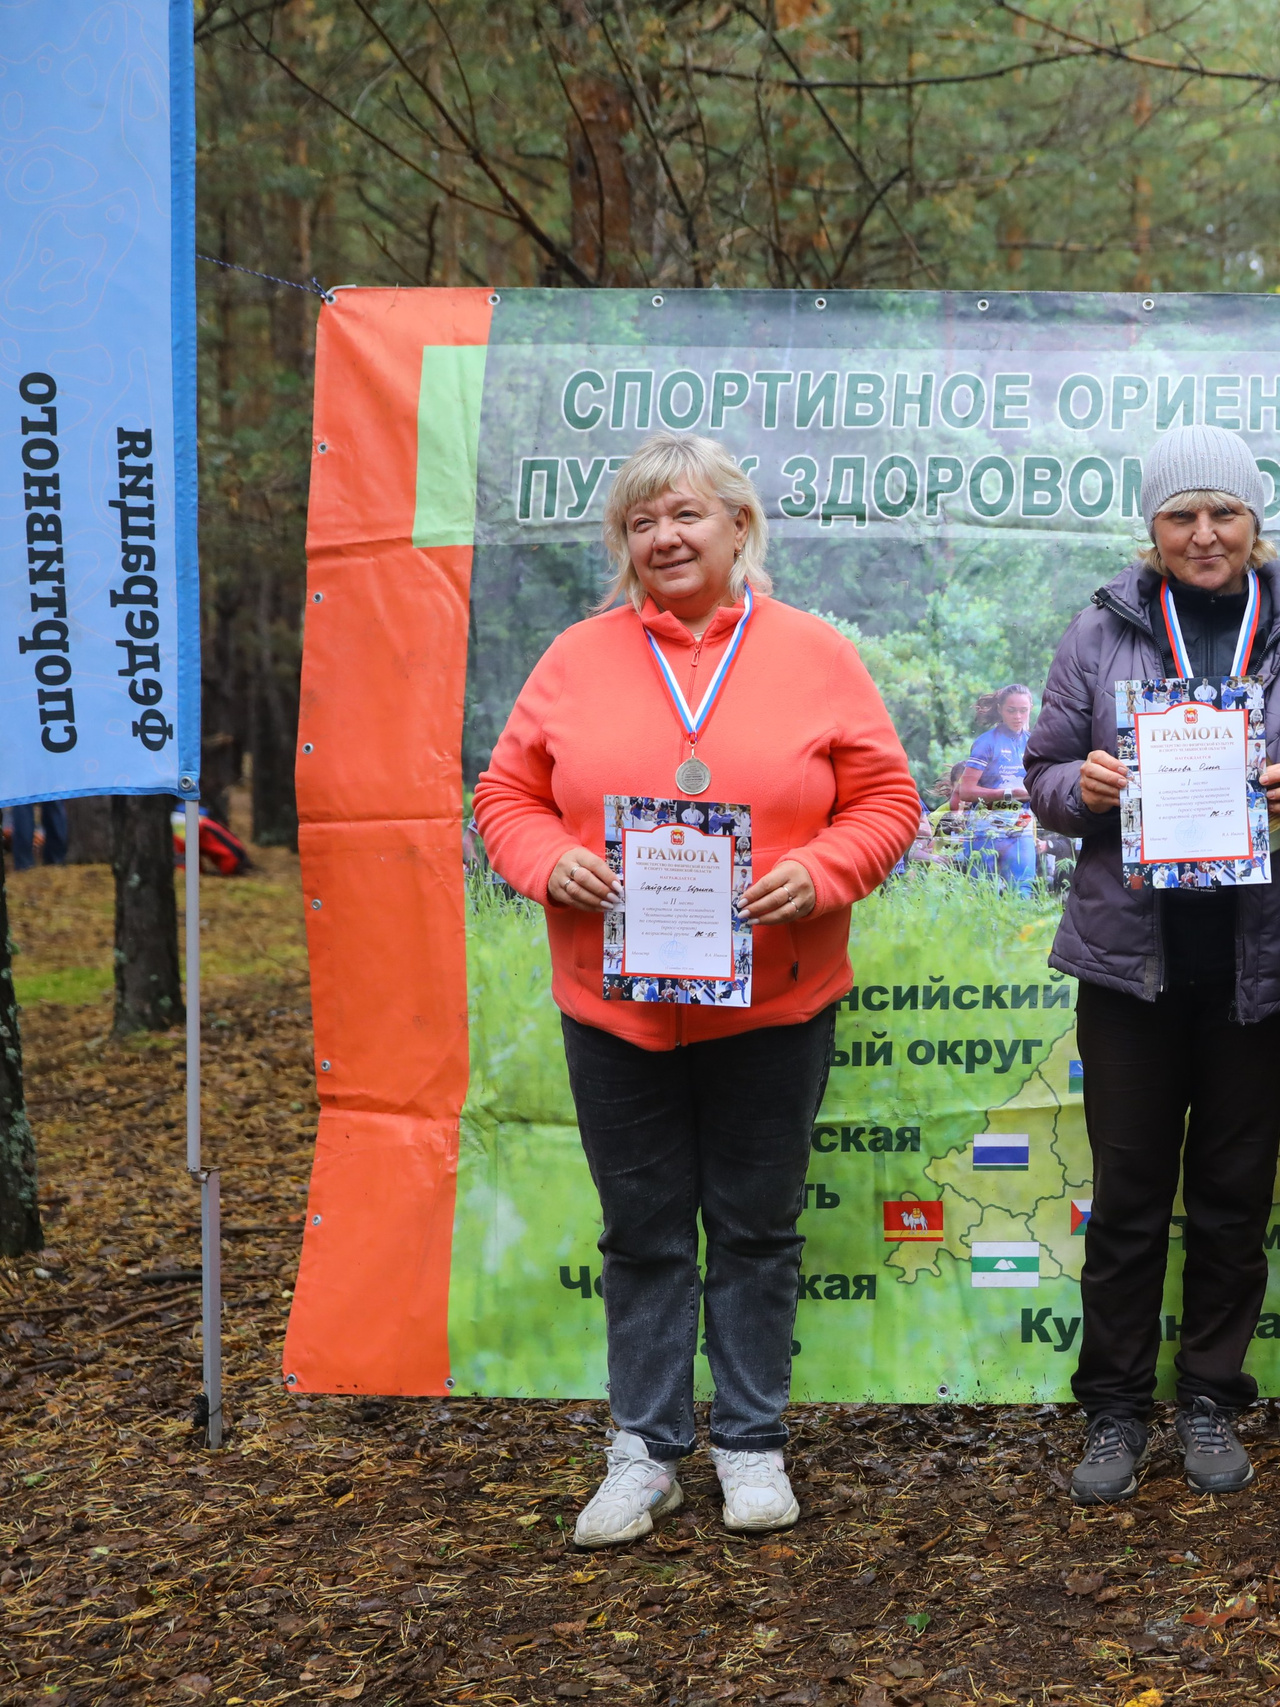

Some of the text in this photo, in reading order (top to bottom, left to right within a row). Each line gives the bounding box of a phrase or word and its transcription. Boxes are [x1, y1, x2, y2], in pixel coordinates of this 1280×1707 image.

[562, 369, 1031, 431] СПОРТИВНОЕ
[780, 455, 1144, 529] ЗДОРОВО
[1151, 726, 1233, 741] ГРАМОТА
[636, 846, 719, 863] ГРАМОТА
[836, 975, 1070, 1012] нсийский
[906, 1038, 1043, 1074] округ
